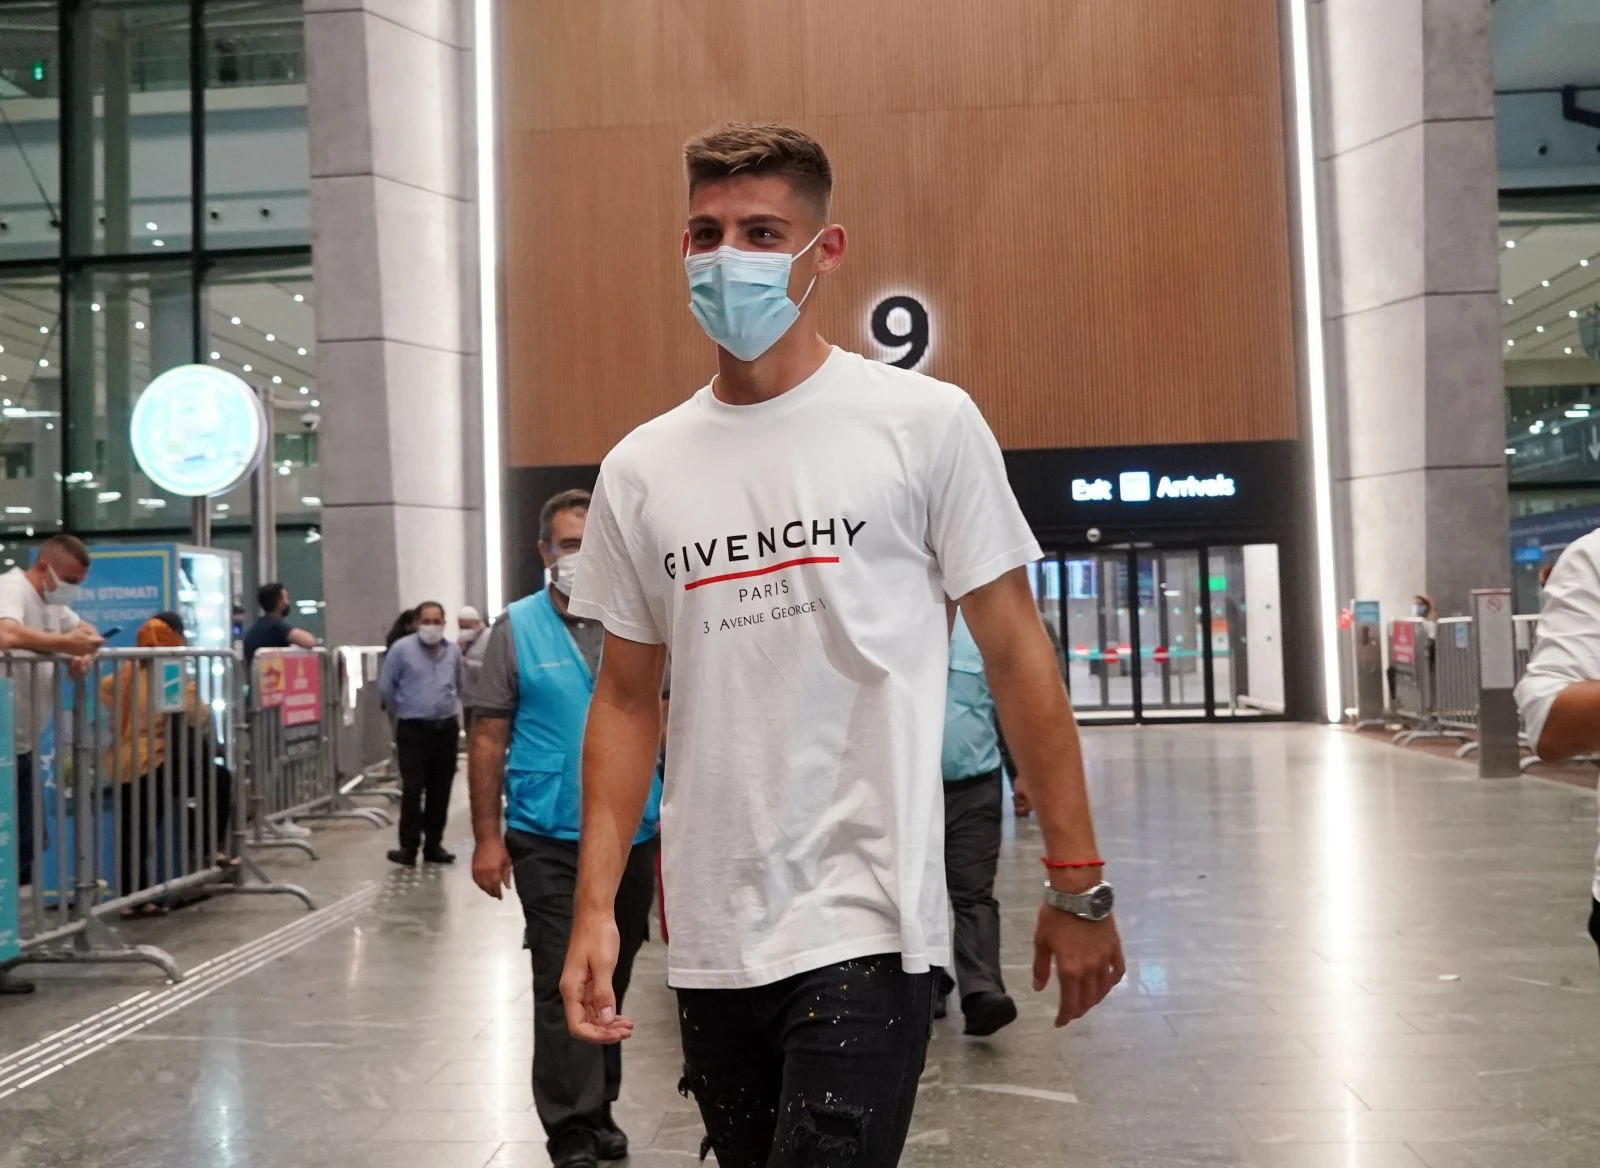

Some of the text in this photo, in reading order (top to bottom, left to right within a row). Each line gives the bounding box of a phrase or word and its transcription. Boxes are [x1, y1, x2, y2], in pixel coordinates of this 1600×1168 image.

[871, 296, 929, 369] 9
[1072, 473, 1236, 501] Exit Arrivals
[663, 518, 866, 580] GIVENCHY
[738, 579, 790, 603] PARIS
